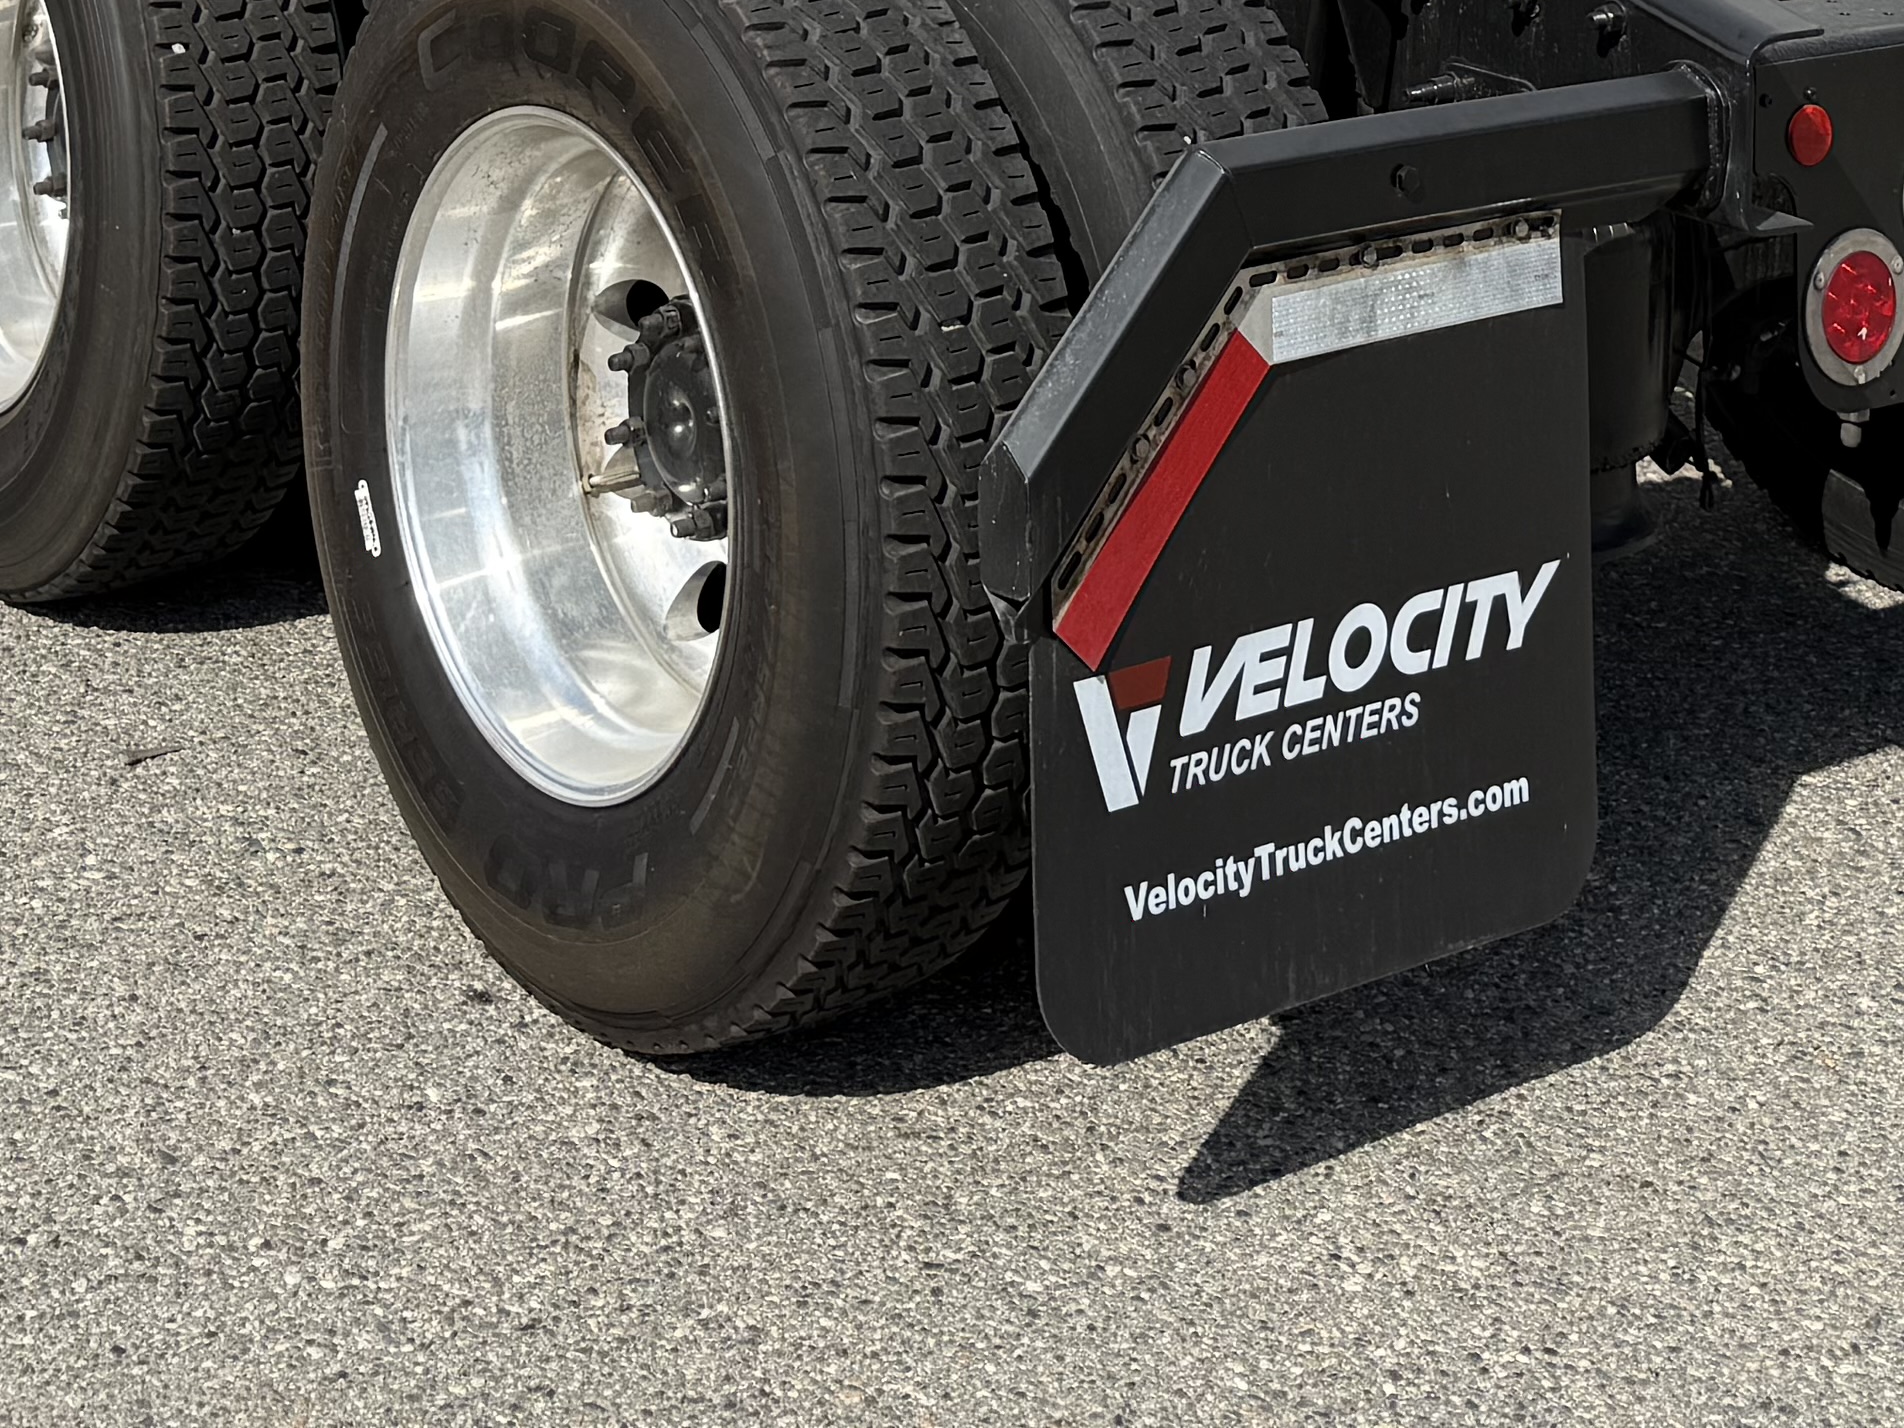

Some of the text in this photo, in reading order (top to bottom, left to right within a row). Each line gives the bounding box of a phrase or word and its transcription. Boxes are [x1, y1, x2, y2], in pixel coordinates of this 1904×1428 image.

[1179, 559, 1561, 738] VELOCITY
[1169, 691, 1421, 794] TRUCK CENTERS
[1124, 777, 1530, 922] VelocityTruckCenters.com
